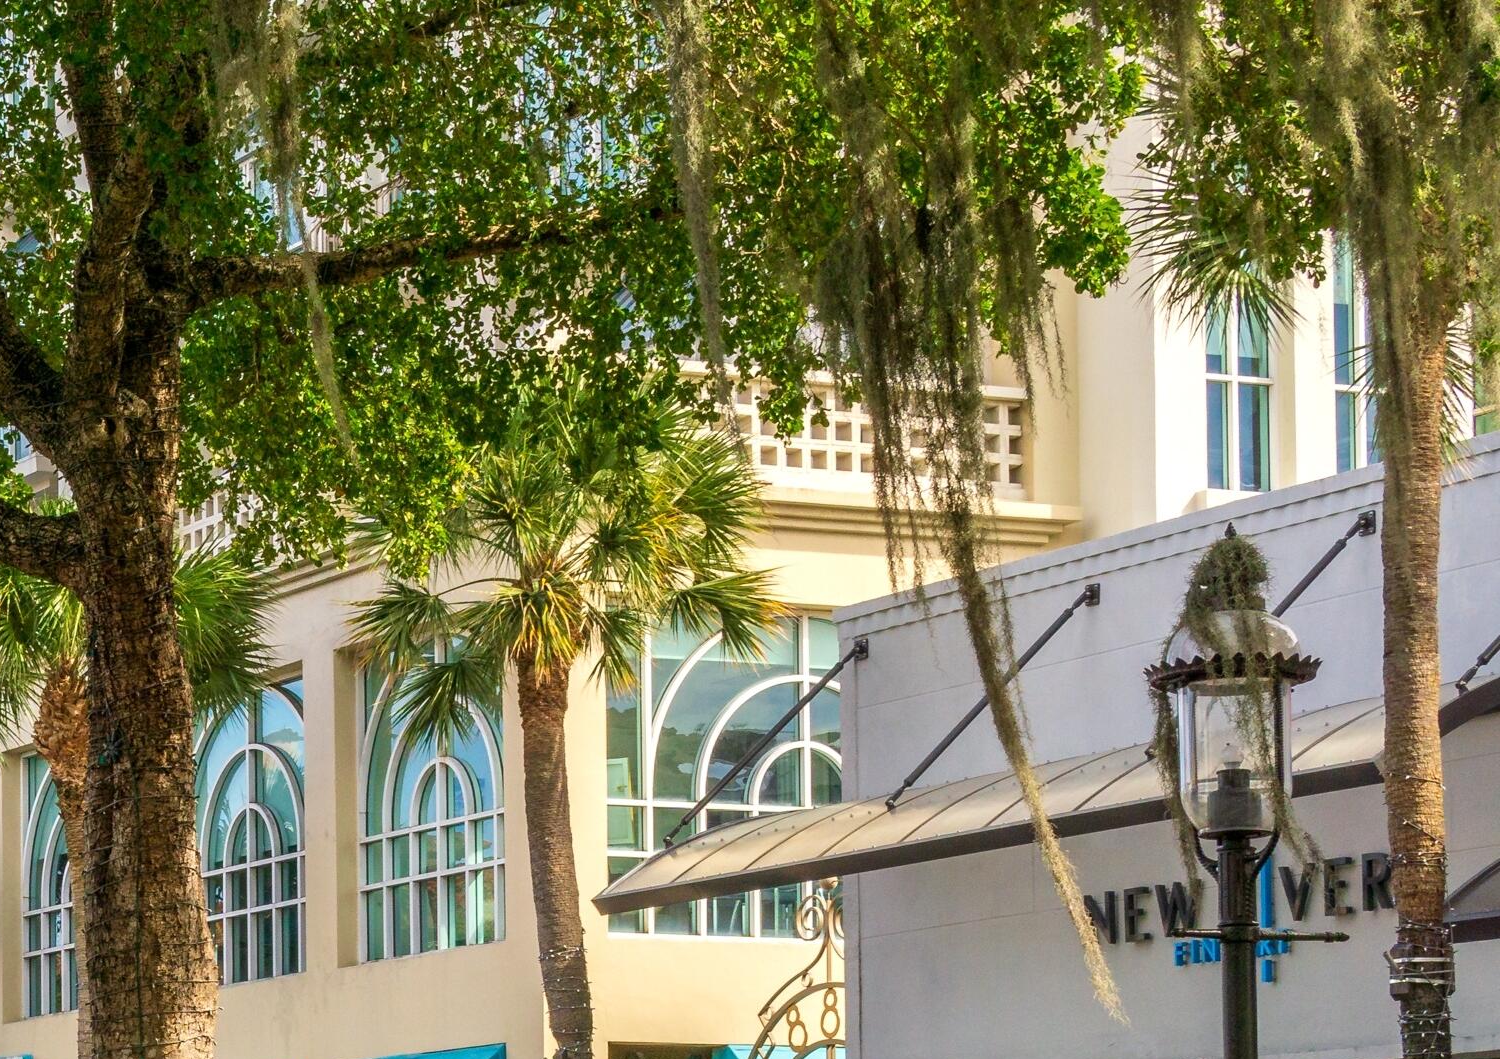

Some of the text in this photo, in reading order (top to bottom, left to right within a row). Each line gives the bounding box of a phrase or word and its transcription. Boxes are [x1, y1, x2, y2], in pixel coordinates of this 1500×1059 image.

[1084, 852, 1396, 944] NEW IVER
[1174, 938, 1221, 966] FIN
